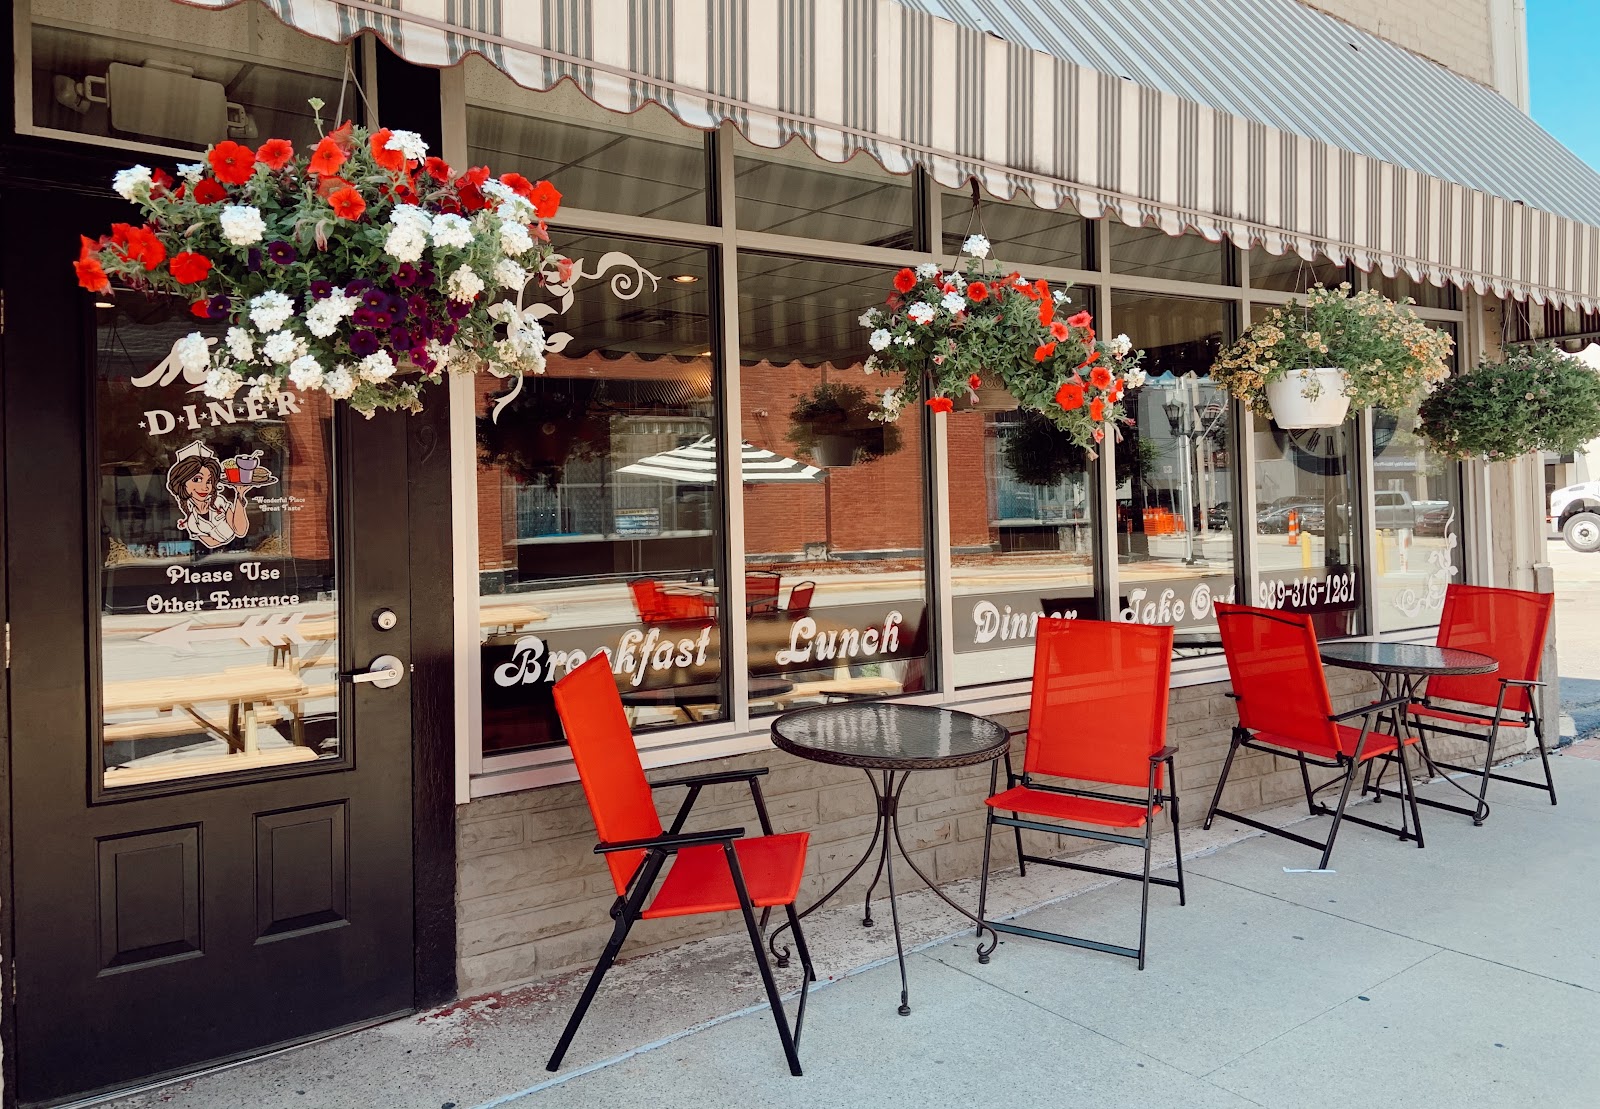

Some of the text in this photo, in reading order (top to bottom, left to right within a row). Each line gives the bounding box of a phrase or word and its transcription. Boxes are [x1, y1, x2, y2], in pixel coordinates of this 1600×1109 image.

[143, 391, 302, 436] DINER
[288, 495, 306, 503] Place
[166, 562, 280, 584] Please Use
[1259, 571, 1357, 611] 989-316-1281
[146, 590, 300, 614] Other Entrance
[1120, 586, 1187, 626] Take
[774, 610, 903, 666] Lunch
